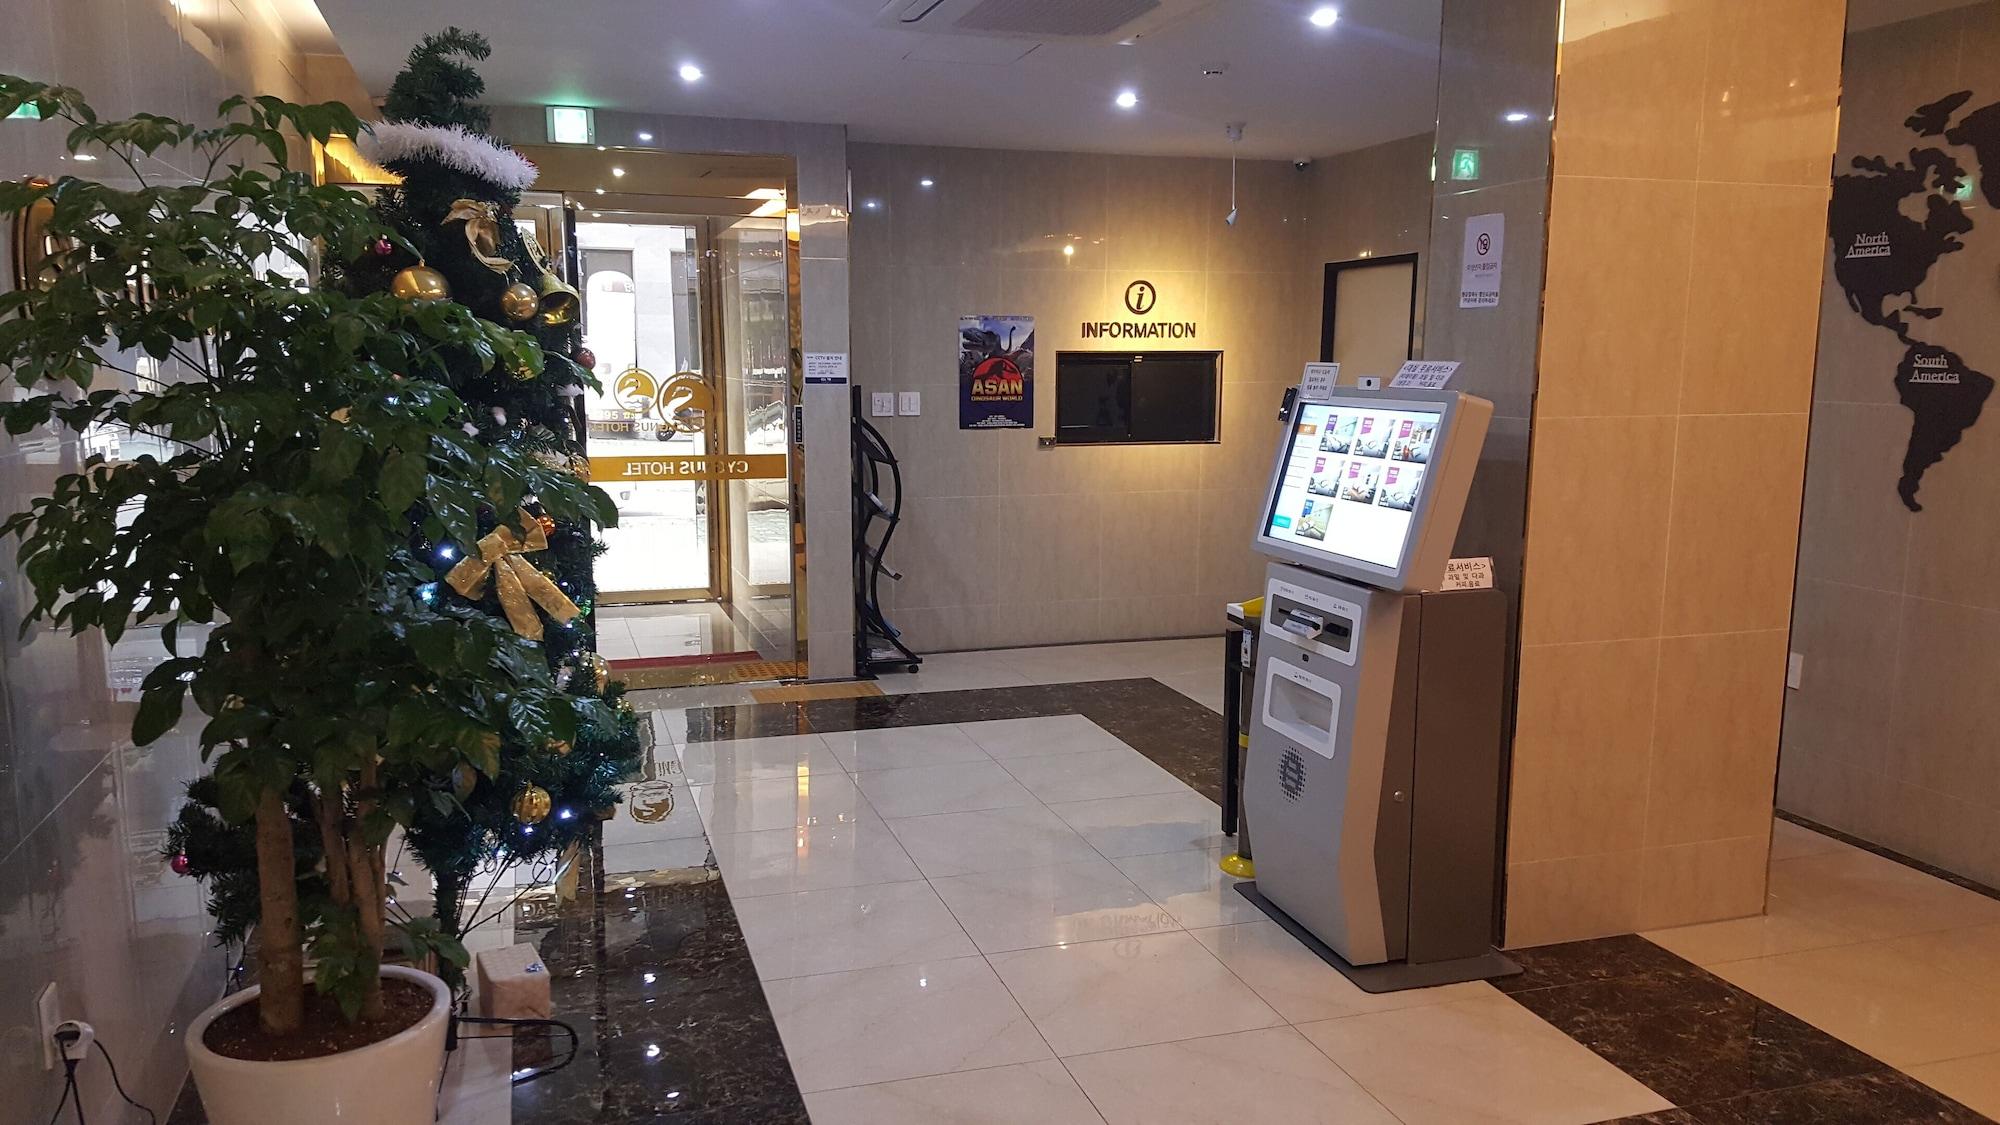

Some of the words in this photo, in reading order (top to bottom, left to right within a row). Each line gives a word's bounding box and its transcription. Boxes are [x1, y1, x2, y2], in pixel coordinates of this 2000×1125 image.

[1854, 231, 1889, 246] North
[1845, 245, 1890, 258] America
[1081, 321, 1196, 339] INFORMATION
[1913, 353, 1949, 369] South
[1909, 369, 1961, 384] America
[971, 379, 1023, 395] ASAN
